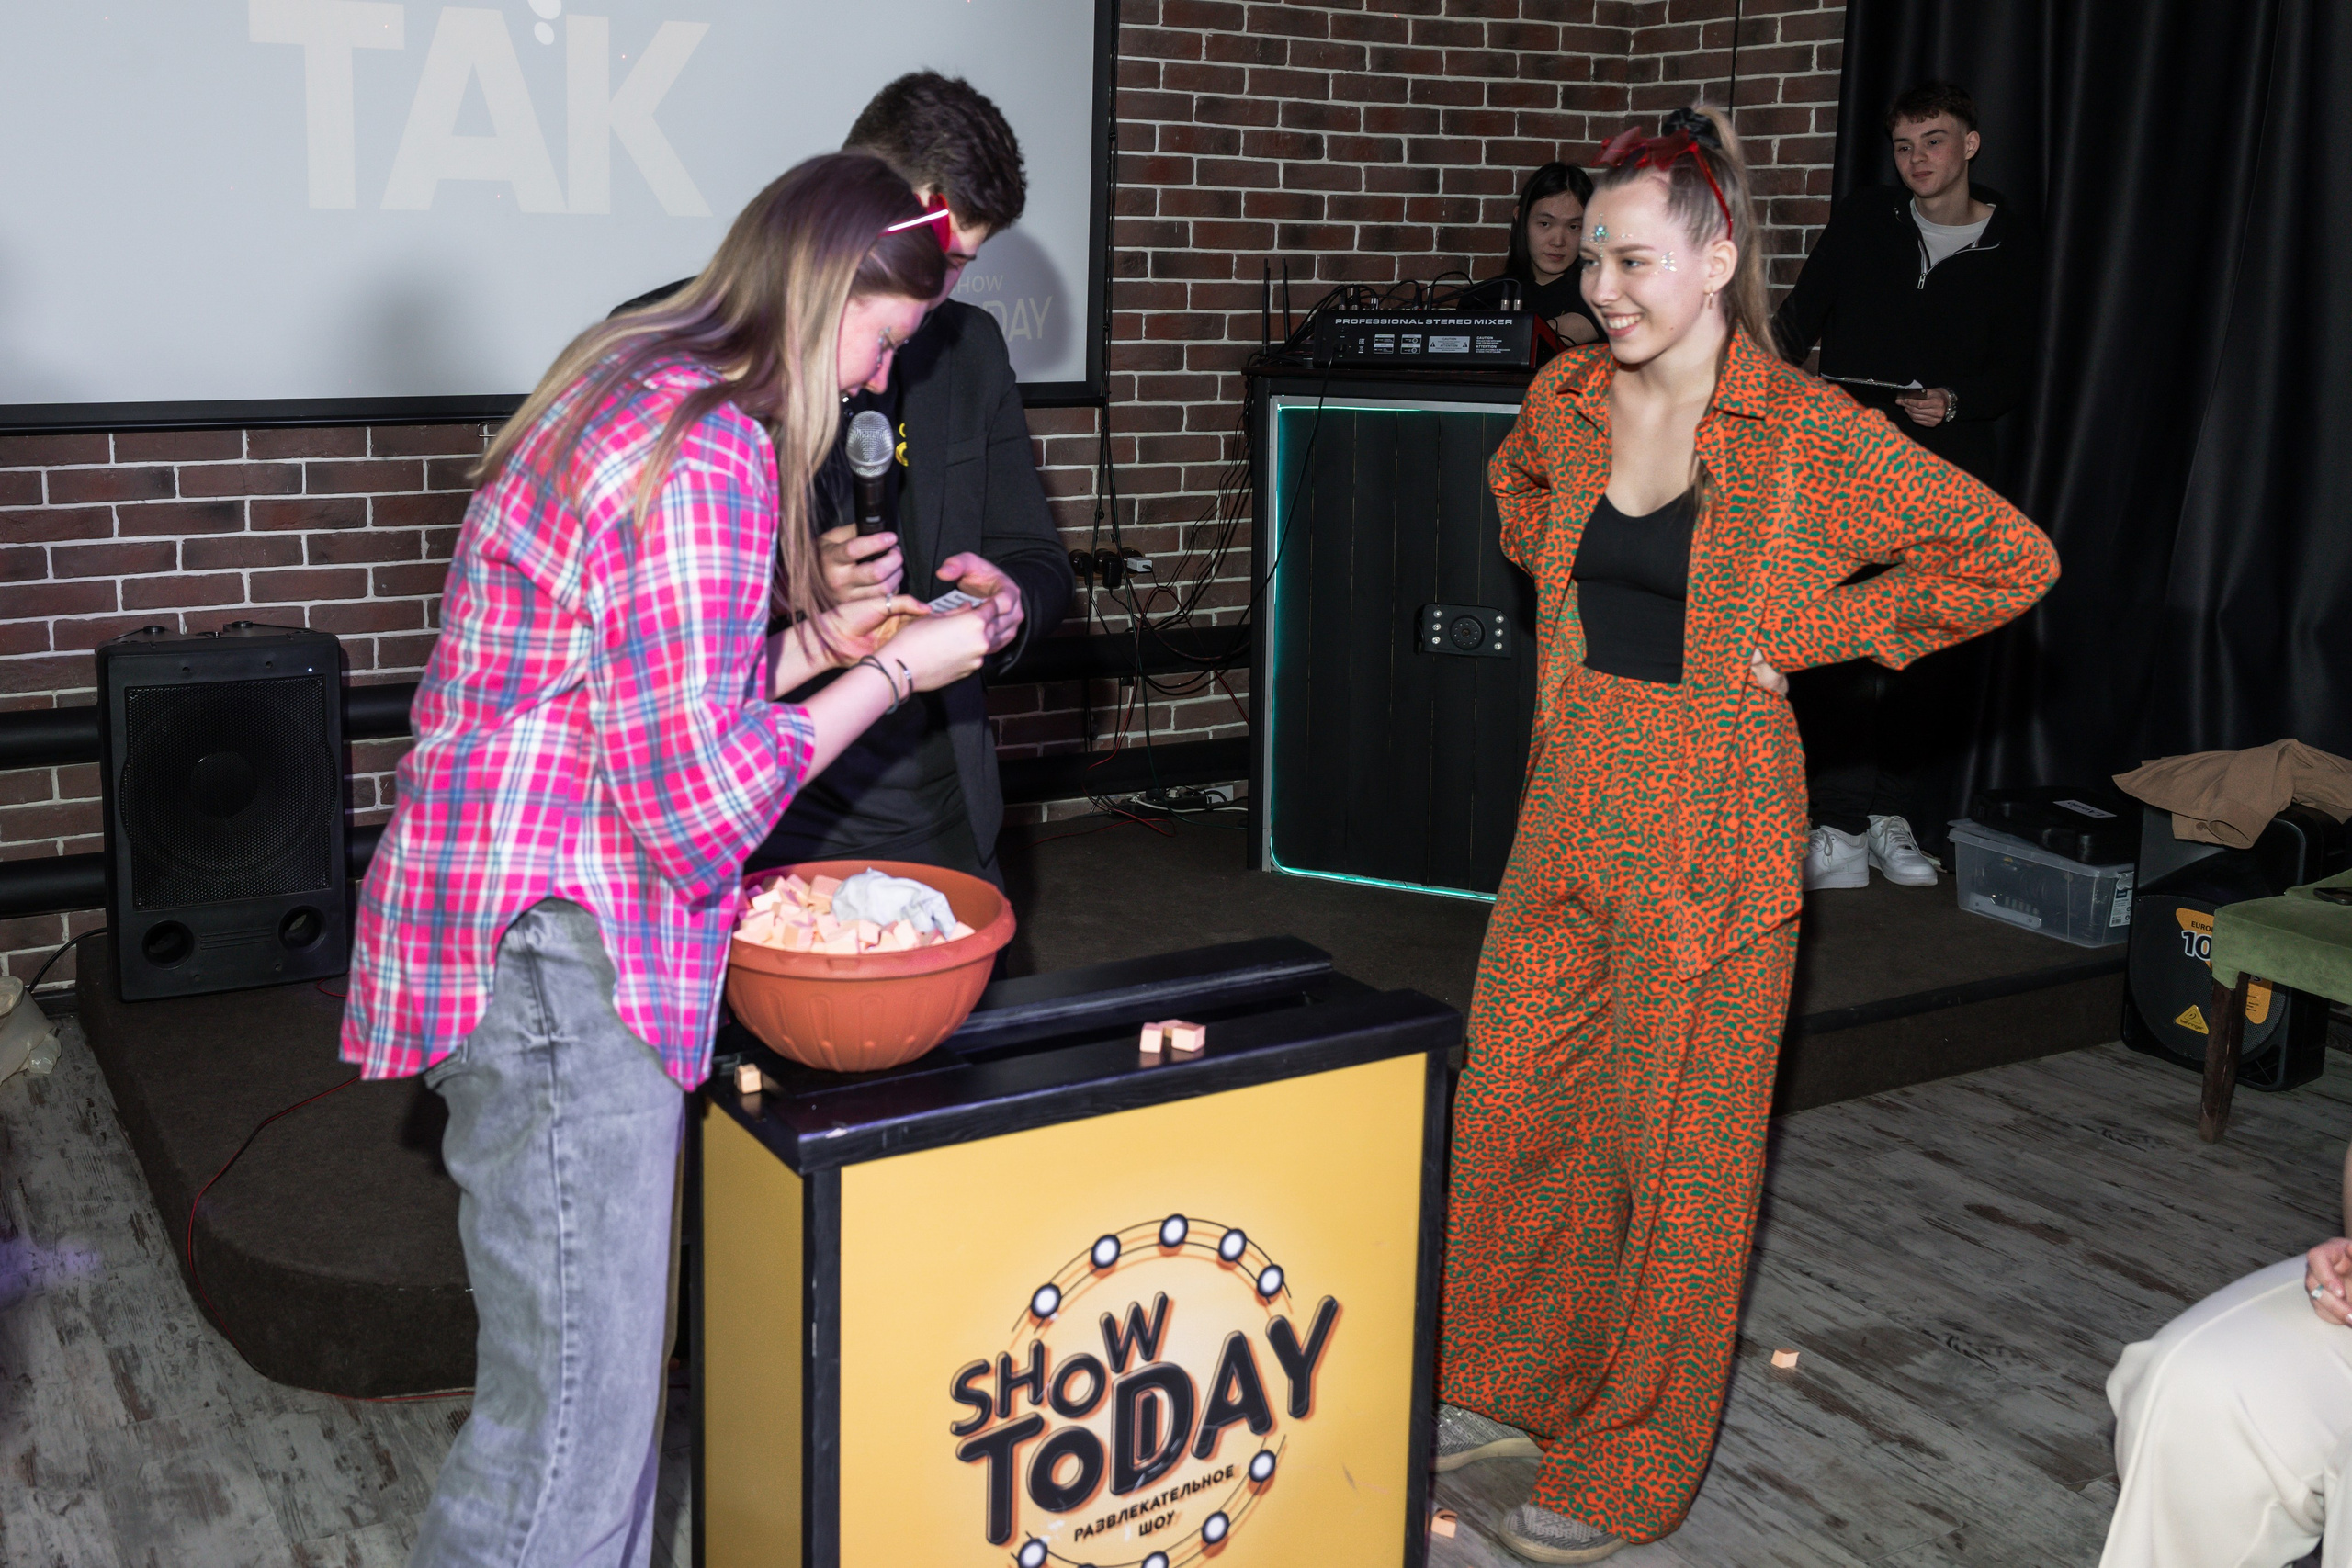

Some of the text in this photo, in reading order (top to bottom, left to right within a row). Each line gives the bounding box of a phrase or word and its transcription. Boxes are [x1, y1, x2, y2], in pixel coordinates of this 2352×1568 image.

[249, 0, 714, 217] ТАК
[952, 275, 1004, 294] HOW
[2190, 920, 2213, 933] EURO
[950, 1291, 1170, 1436] SHOW
[956, 1295, 1340, 1545] TODAY
[1074, 1464, 1235, 1541] РАЗВЛЕКАТЕЛЬНОЕ
[1138, 1511, 1176, 1537] ШОУ
